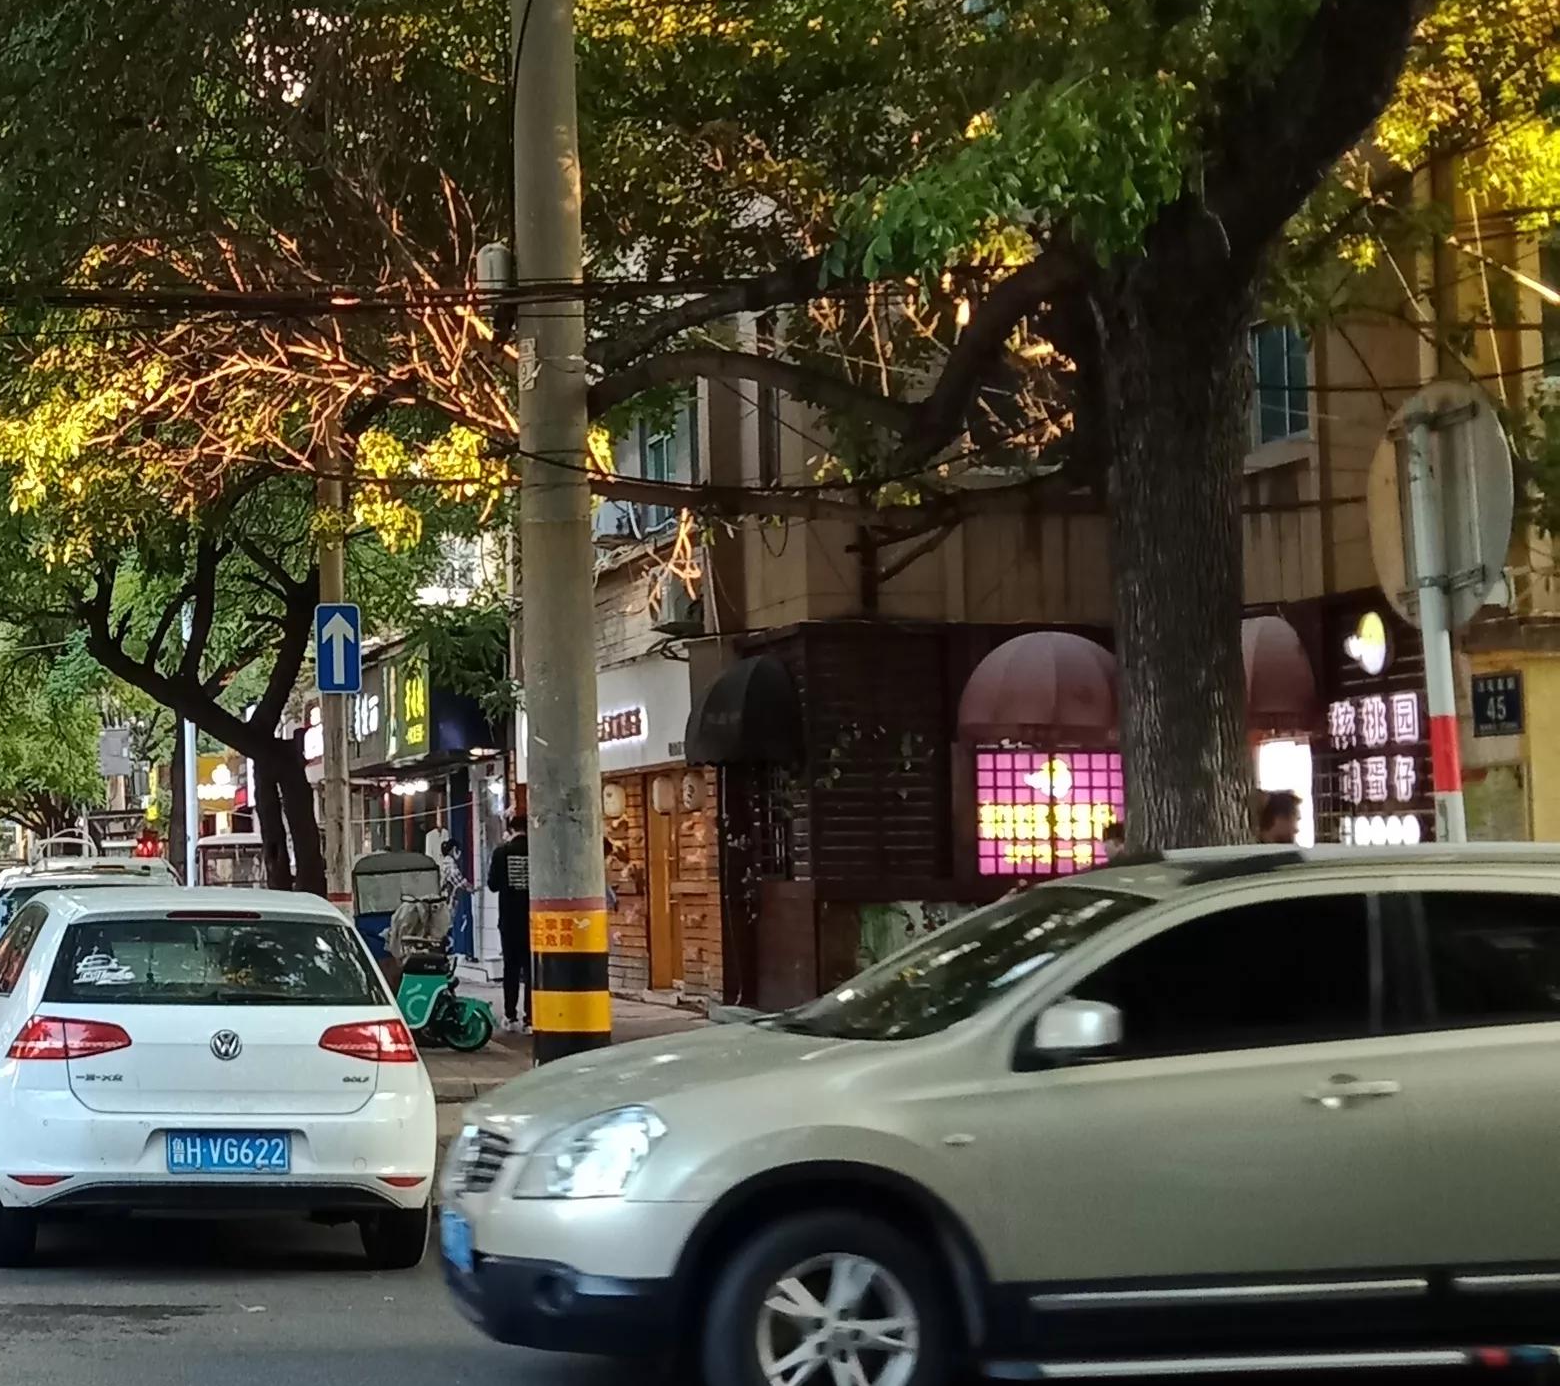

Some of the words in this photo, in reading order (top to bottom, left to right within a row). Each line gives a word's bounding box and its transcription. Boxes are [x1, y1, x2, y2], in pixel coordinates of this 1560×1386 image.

[1329, 691, 1420, 750] 核桃园
[1486, 695, 1507, 721] 45
[1338, 754, 1416, 805] 鸡蛋仔
